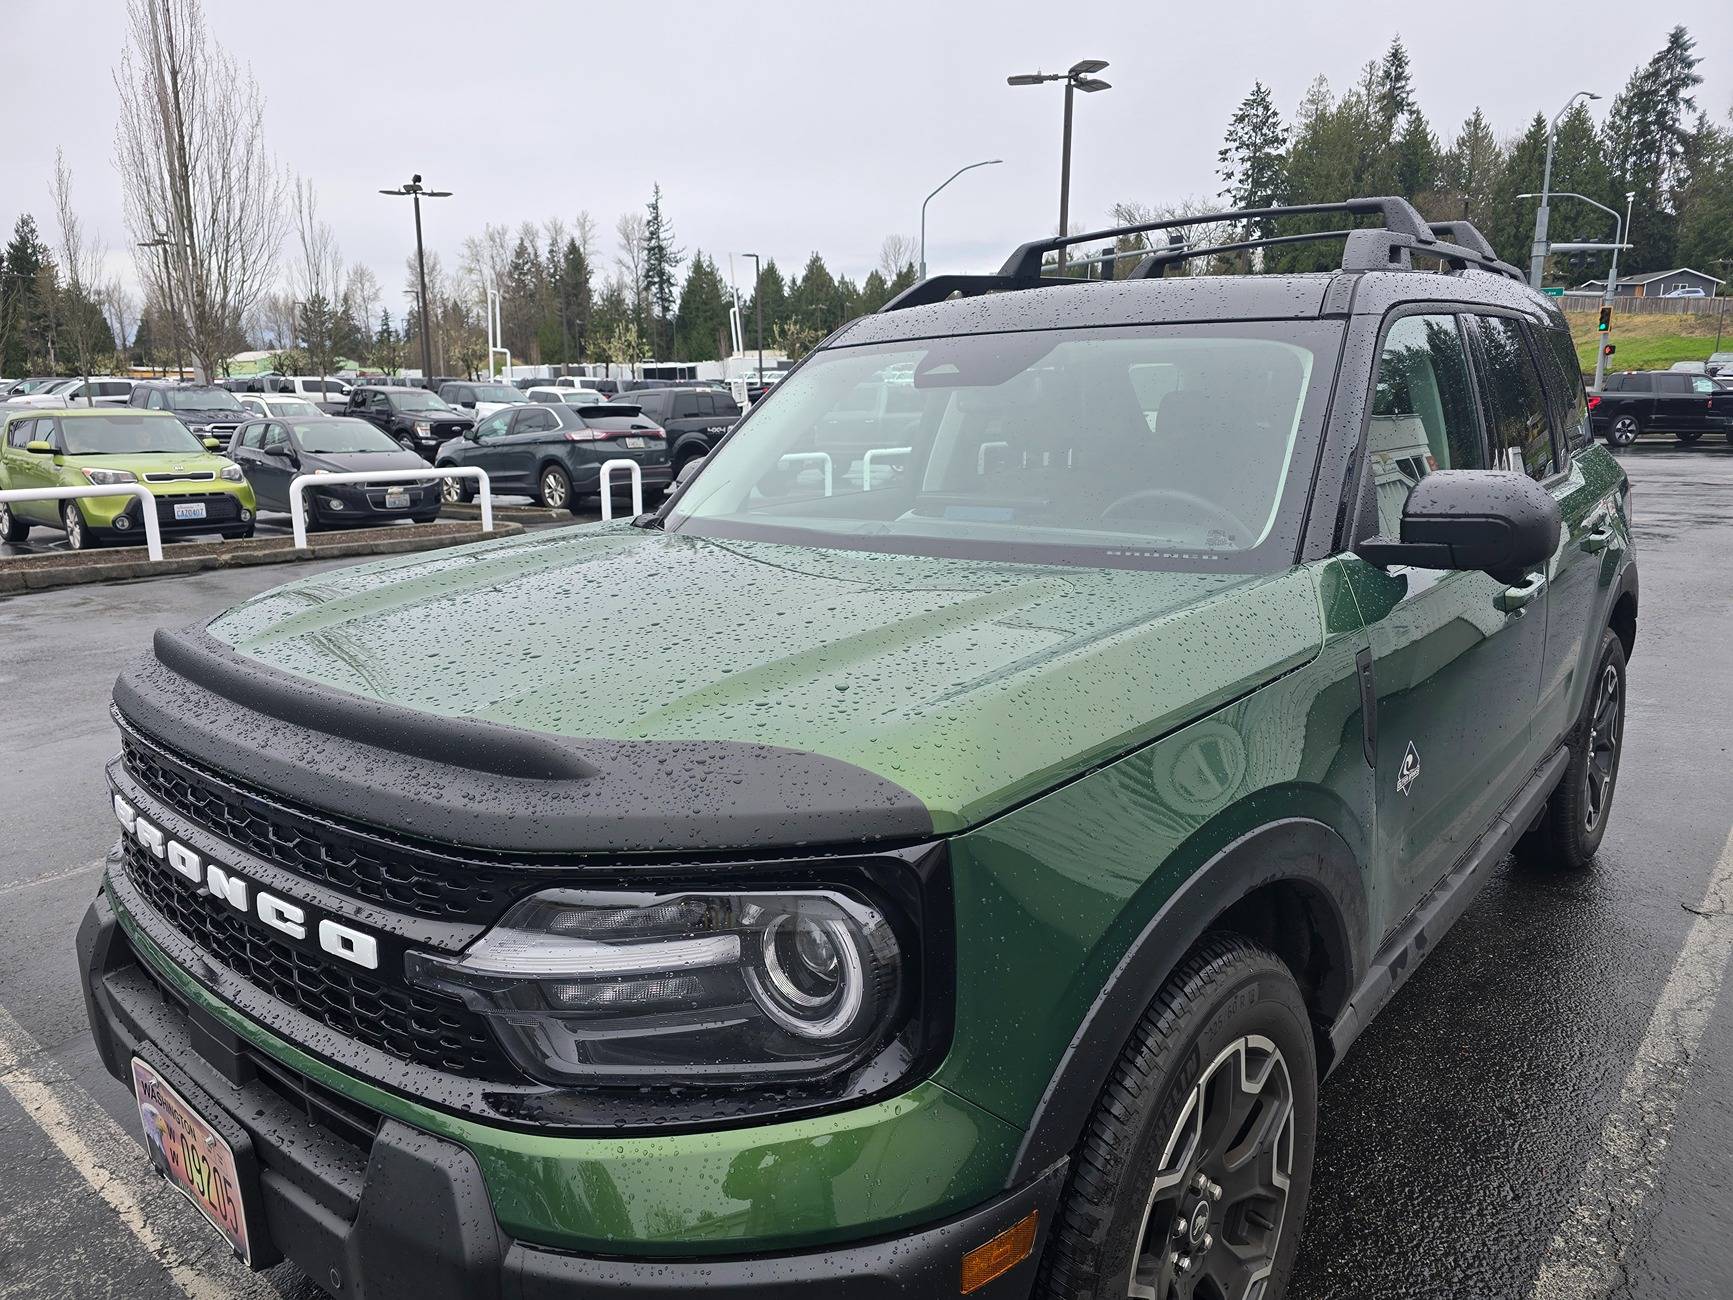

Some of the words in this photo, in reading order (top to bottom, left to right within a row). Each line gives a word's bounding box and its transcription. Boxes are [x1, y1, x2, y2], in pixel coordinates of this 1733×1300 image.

[114, 794, 379, 970] BRONCO
[141, 1080, 197, 1142] WASHINGTON
[166, 1124, 176, 1144] W
[169, 1147, 179, 1167] W
[180, 1132, 239, 1235] 09205
